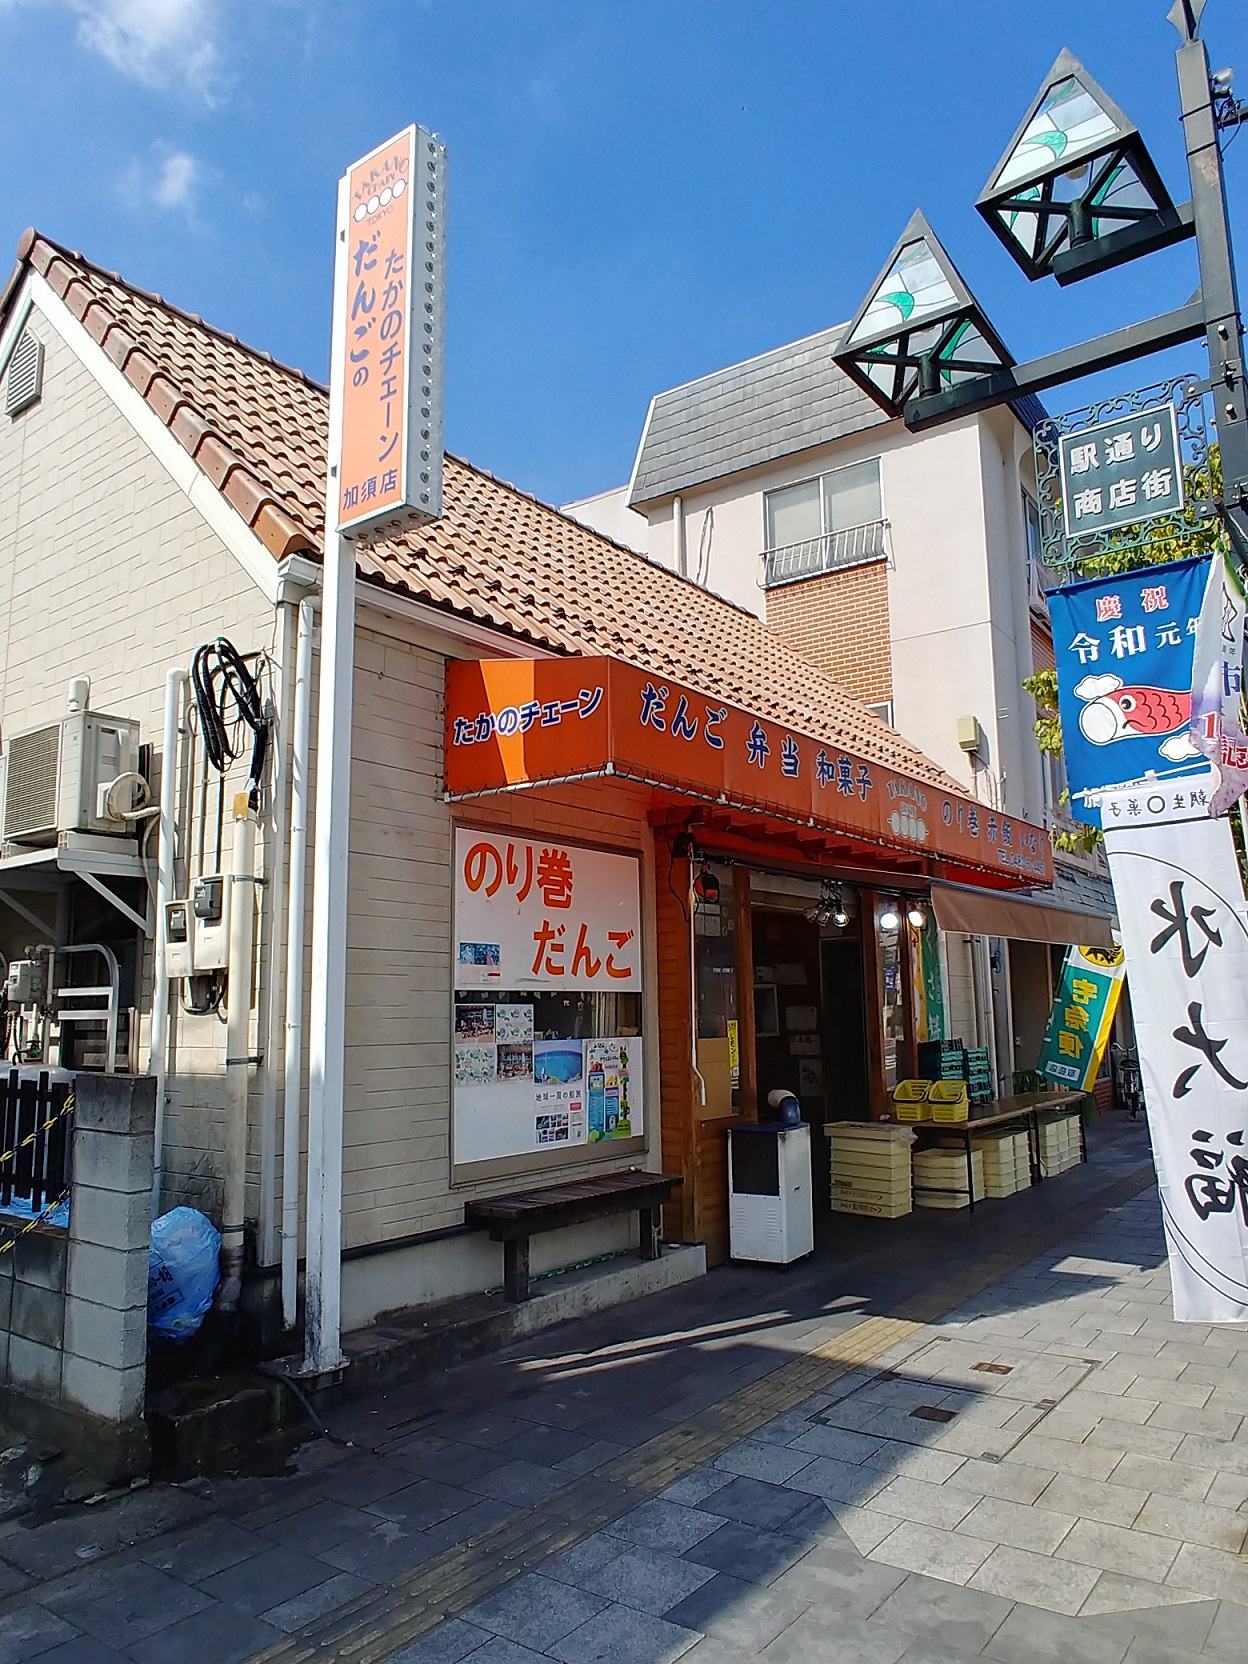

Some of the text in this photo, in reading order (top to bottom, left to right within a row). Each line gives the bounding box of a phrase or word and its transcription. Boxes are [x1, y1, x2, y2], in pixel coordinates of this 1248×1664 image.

[367, 205, 394, 226] TOKYO
[1069, 422, 1162, 476] 駅通り
[342, 468, 399, 512] 加須店
[1072, 467, 1173, 520] 商店街
[1096, 586, 1170, 622] 慶祝
[452, 686, 605, 747] たかのチェーン
[638, 680, 874, 802] だんご 弁当 和菓子
[942, 800, 980, 838] のり巻
[463, 841, 575, 911] のり巻
[531, 917, 635, 980] だんご
